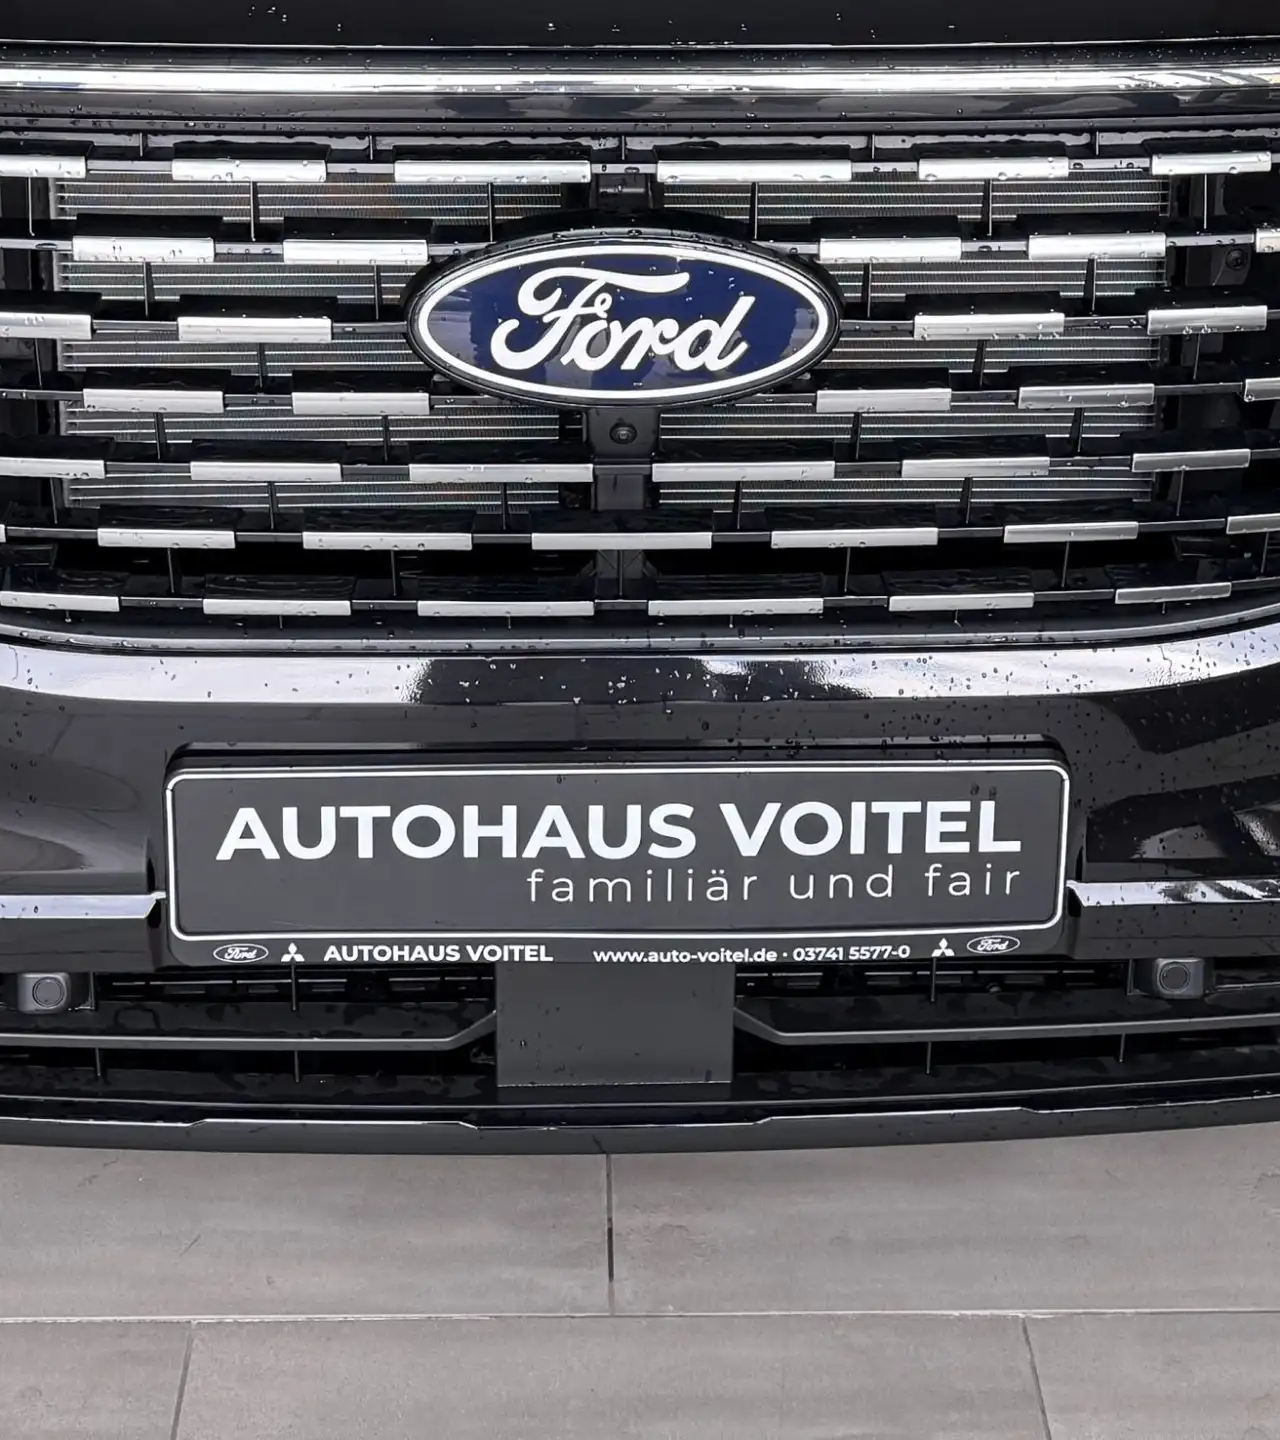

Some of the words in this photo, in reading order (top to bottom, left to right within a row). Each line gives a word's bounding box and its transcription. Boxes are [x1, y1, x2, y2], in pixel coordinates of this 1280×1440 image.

[489, 266, 756, 372] Ford
[215, 803, 698, 861] AUTOHAUS
[719, 800, 1021, 857] VOITEL
[526, 867, 758, 903] familiär
[788, 864, 894, 900] und
[923, 863, 1021, 898] fair
[323, 944, 461, 962] AUTOHAUS
[465, 944, 554, 962] VOITEL
[592, 946, 778, 963] www.auto-voitel.de
[792, 946, 844, 961] 03741
[848, 944, 911, 960] 5577-0
